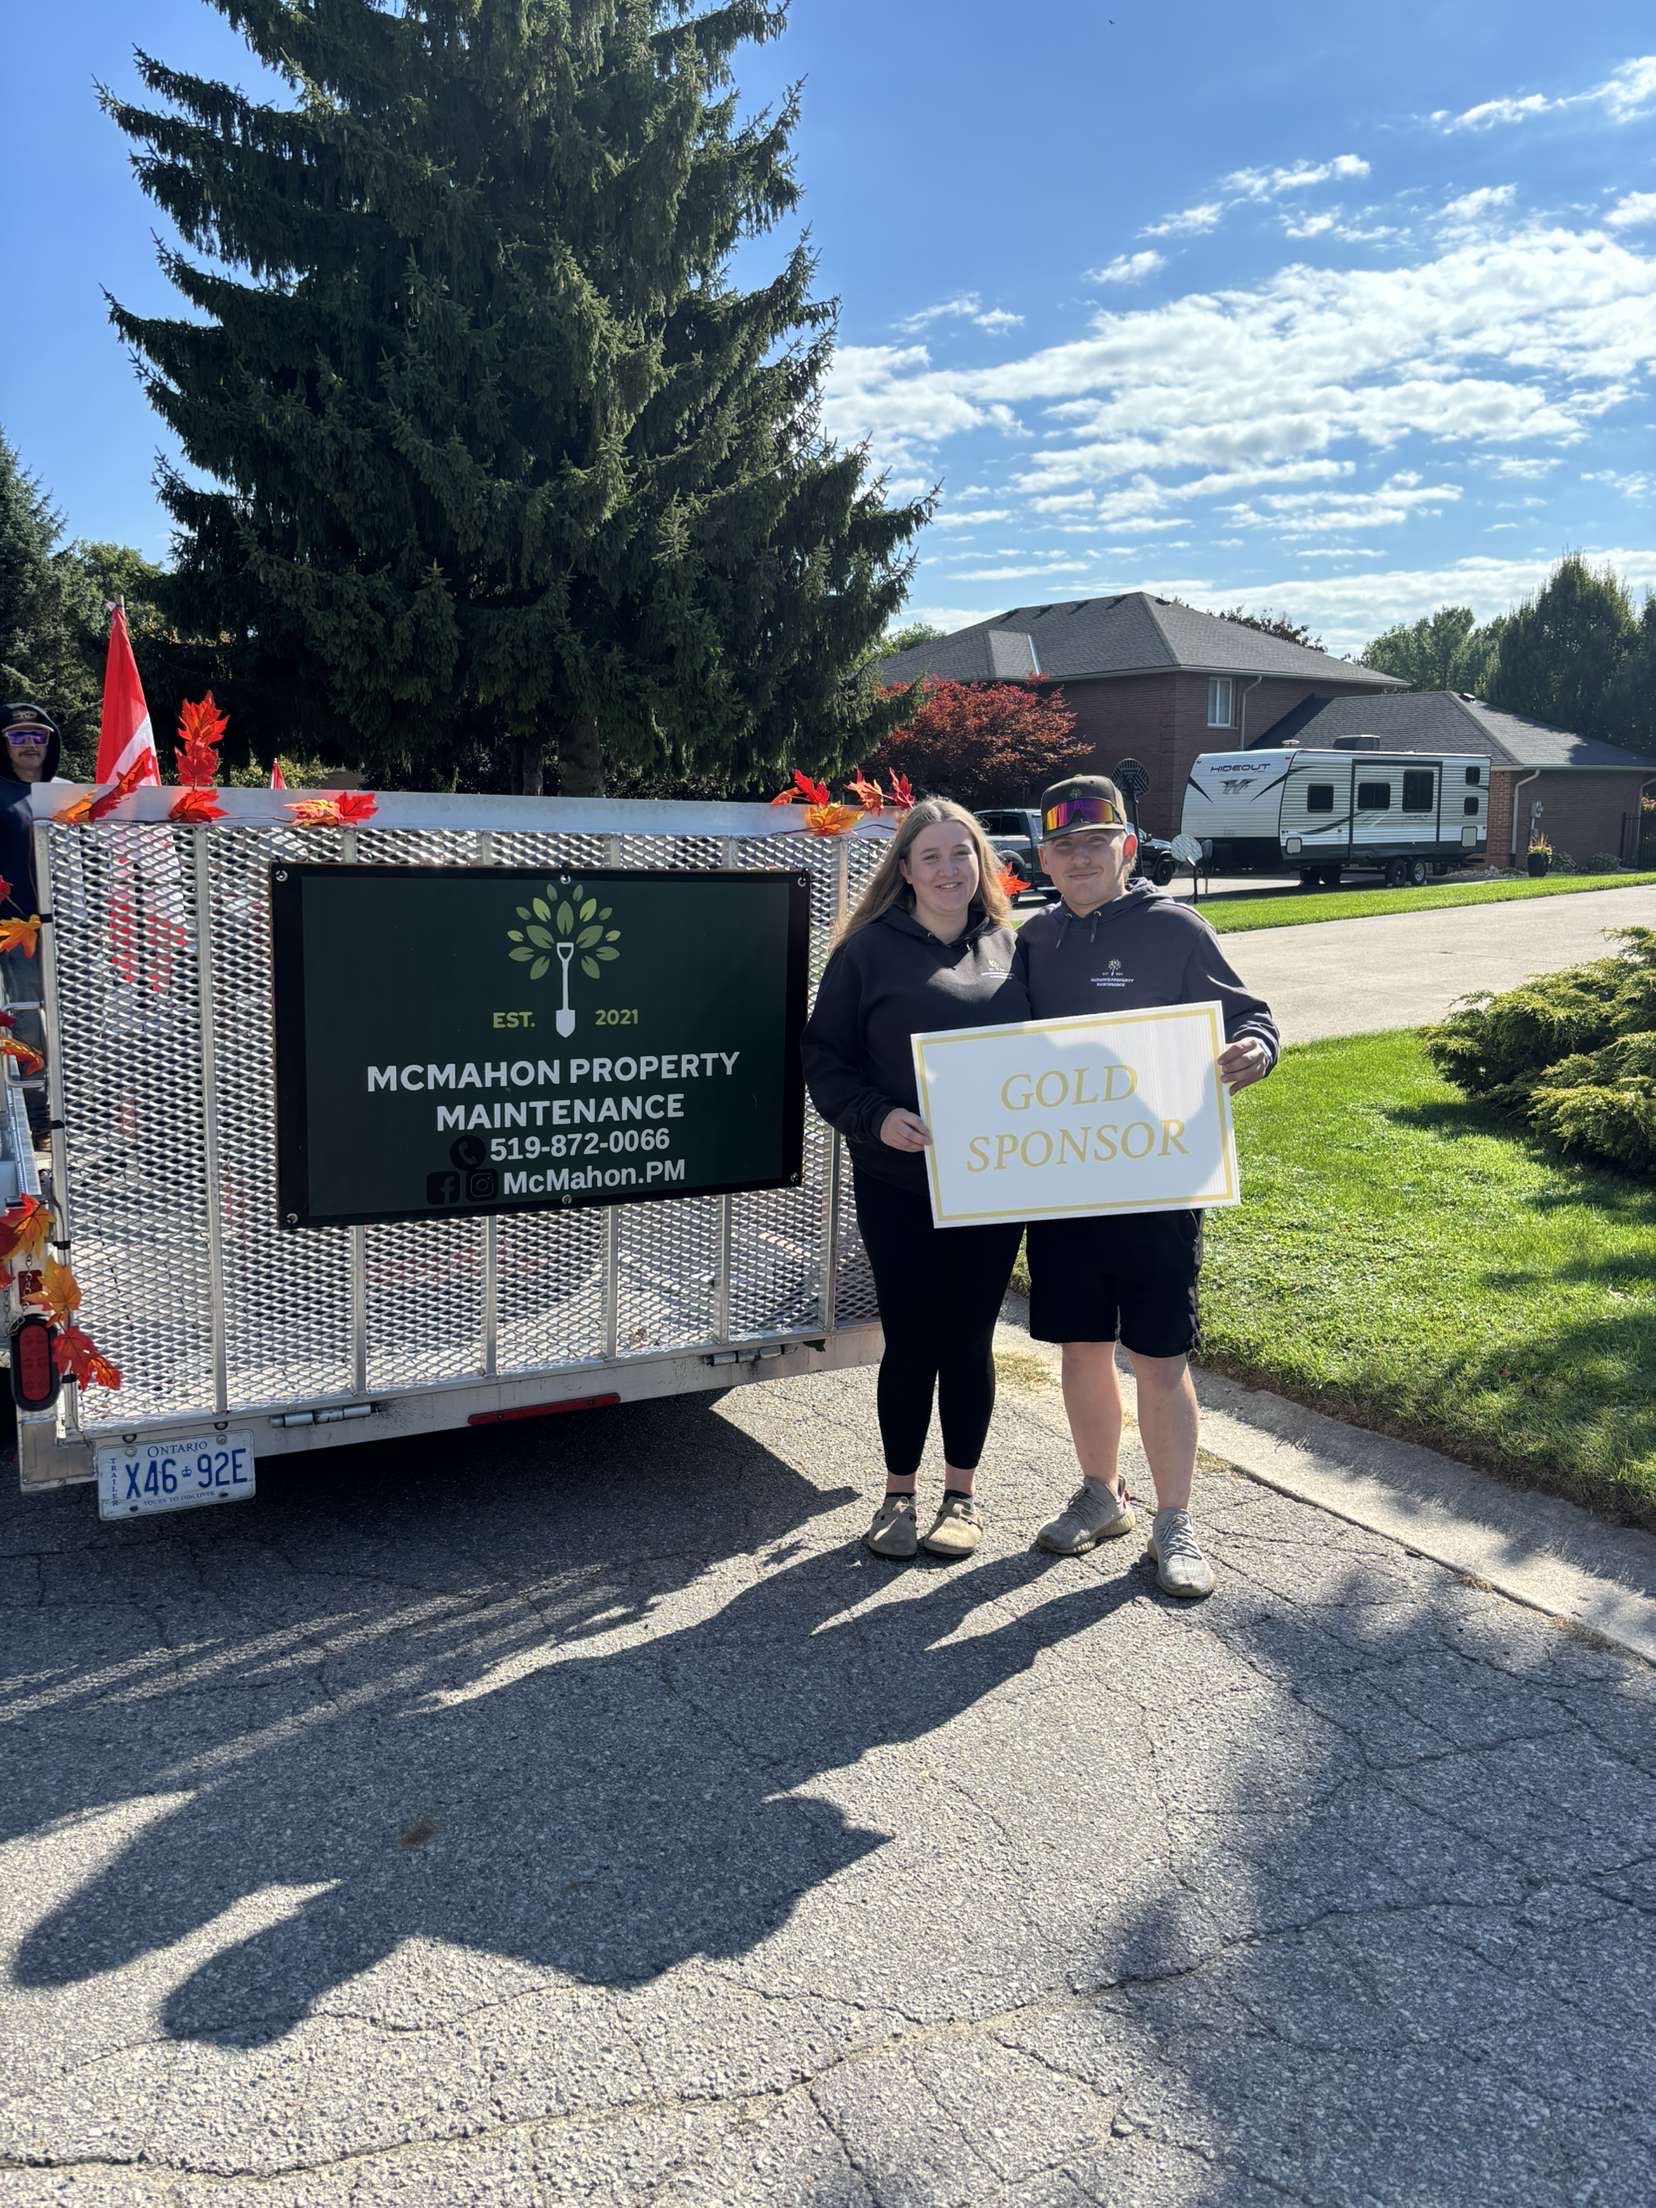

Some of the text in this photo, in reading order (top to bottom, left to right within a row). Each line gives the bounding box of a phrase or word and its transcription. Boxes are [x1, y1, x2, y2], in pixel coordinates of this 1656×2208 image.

[1210, 763, 1271, 773] HIDEOUT
[492, 1009, 639, 1029] EST. 2021
[367, 1051, 740, 1092] MCMAHON PROPERTY
[1000, 1064, 1138, 1112] GOLD
[436, 1093, 685, 1132] MAINTENANCE
[490, 1127, 671, 1161] 519-872-0066
[966, 1119, 1189, 1173] SPONSOR
[503, 1159, 686, 1195] McMahon.PM
[147, 1441, 208, 1458] ONTARIO
[109, 1457, 121, 1507] TRAILER
[125, 1448, 248, 1499] X46 92E
